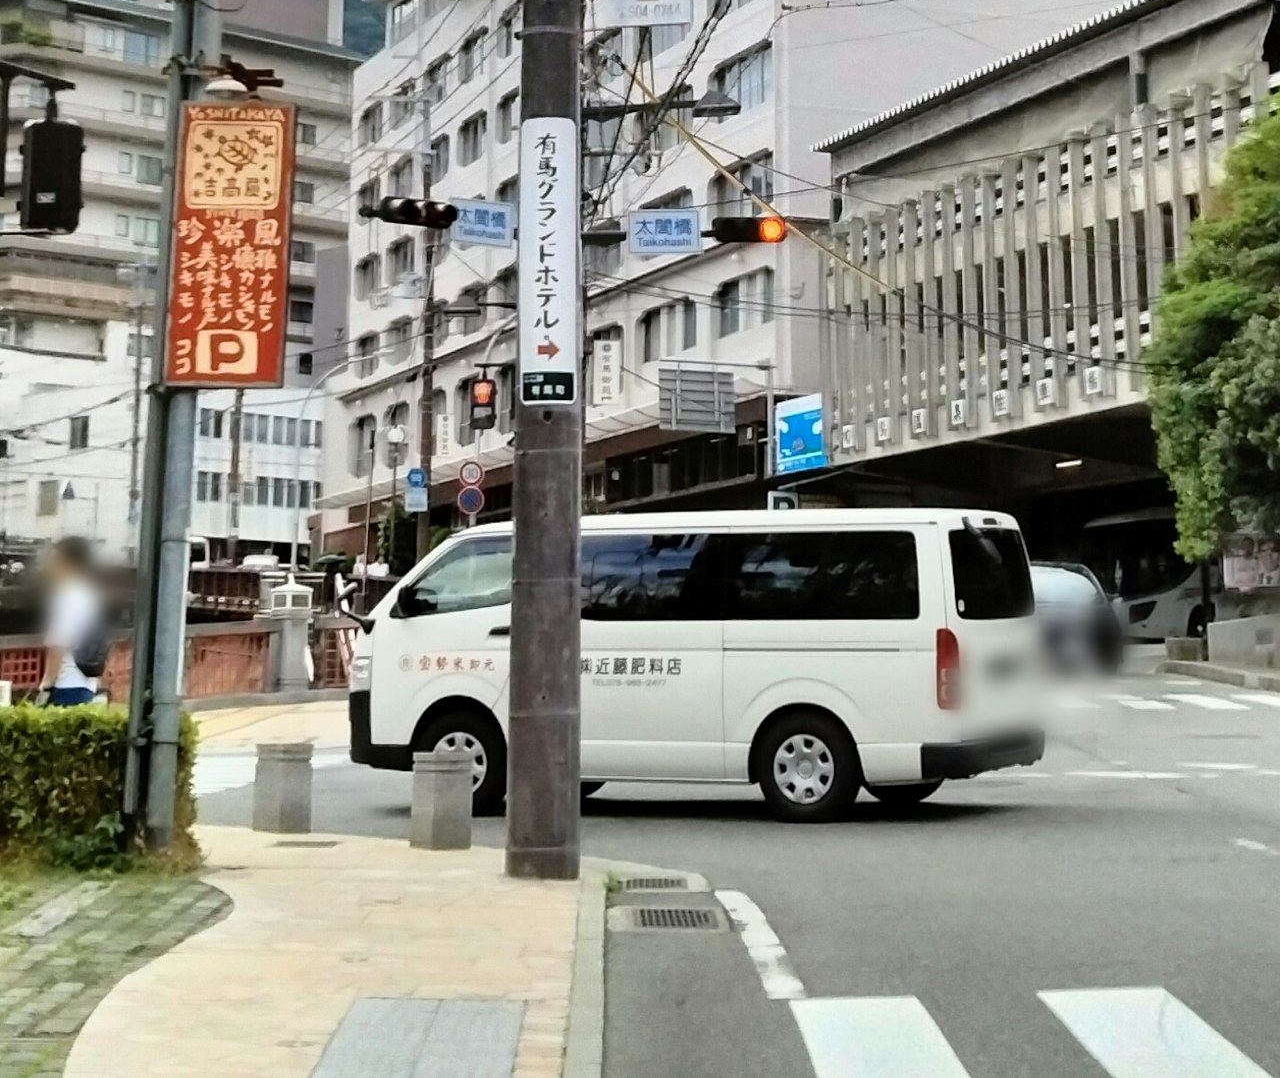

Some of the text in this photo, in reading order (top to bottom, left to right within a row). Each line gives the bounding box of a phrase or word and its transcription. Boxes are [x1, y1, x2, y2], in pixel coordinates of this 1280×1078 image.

[204, 178, 261, 197] 吉高屋
[457, 208, 506, 229] 太閤橋
[635, 218, 692, 236] 太閤橋
[535, 132, 560, 329] 有馬グランドホテル
[637, 237, 692, 248] Taikohashi
[210, 333, 245, 371] P
